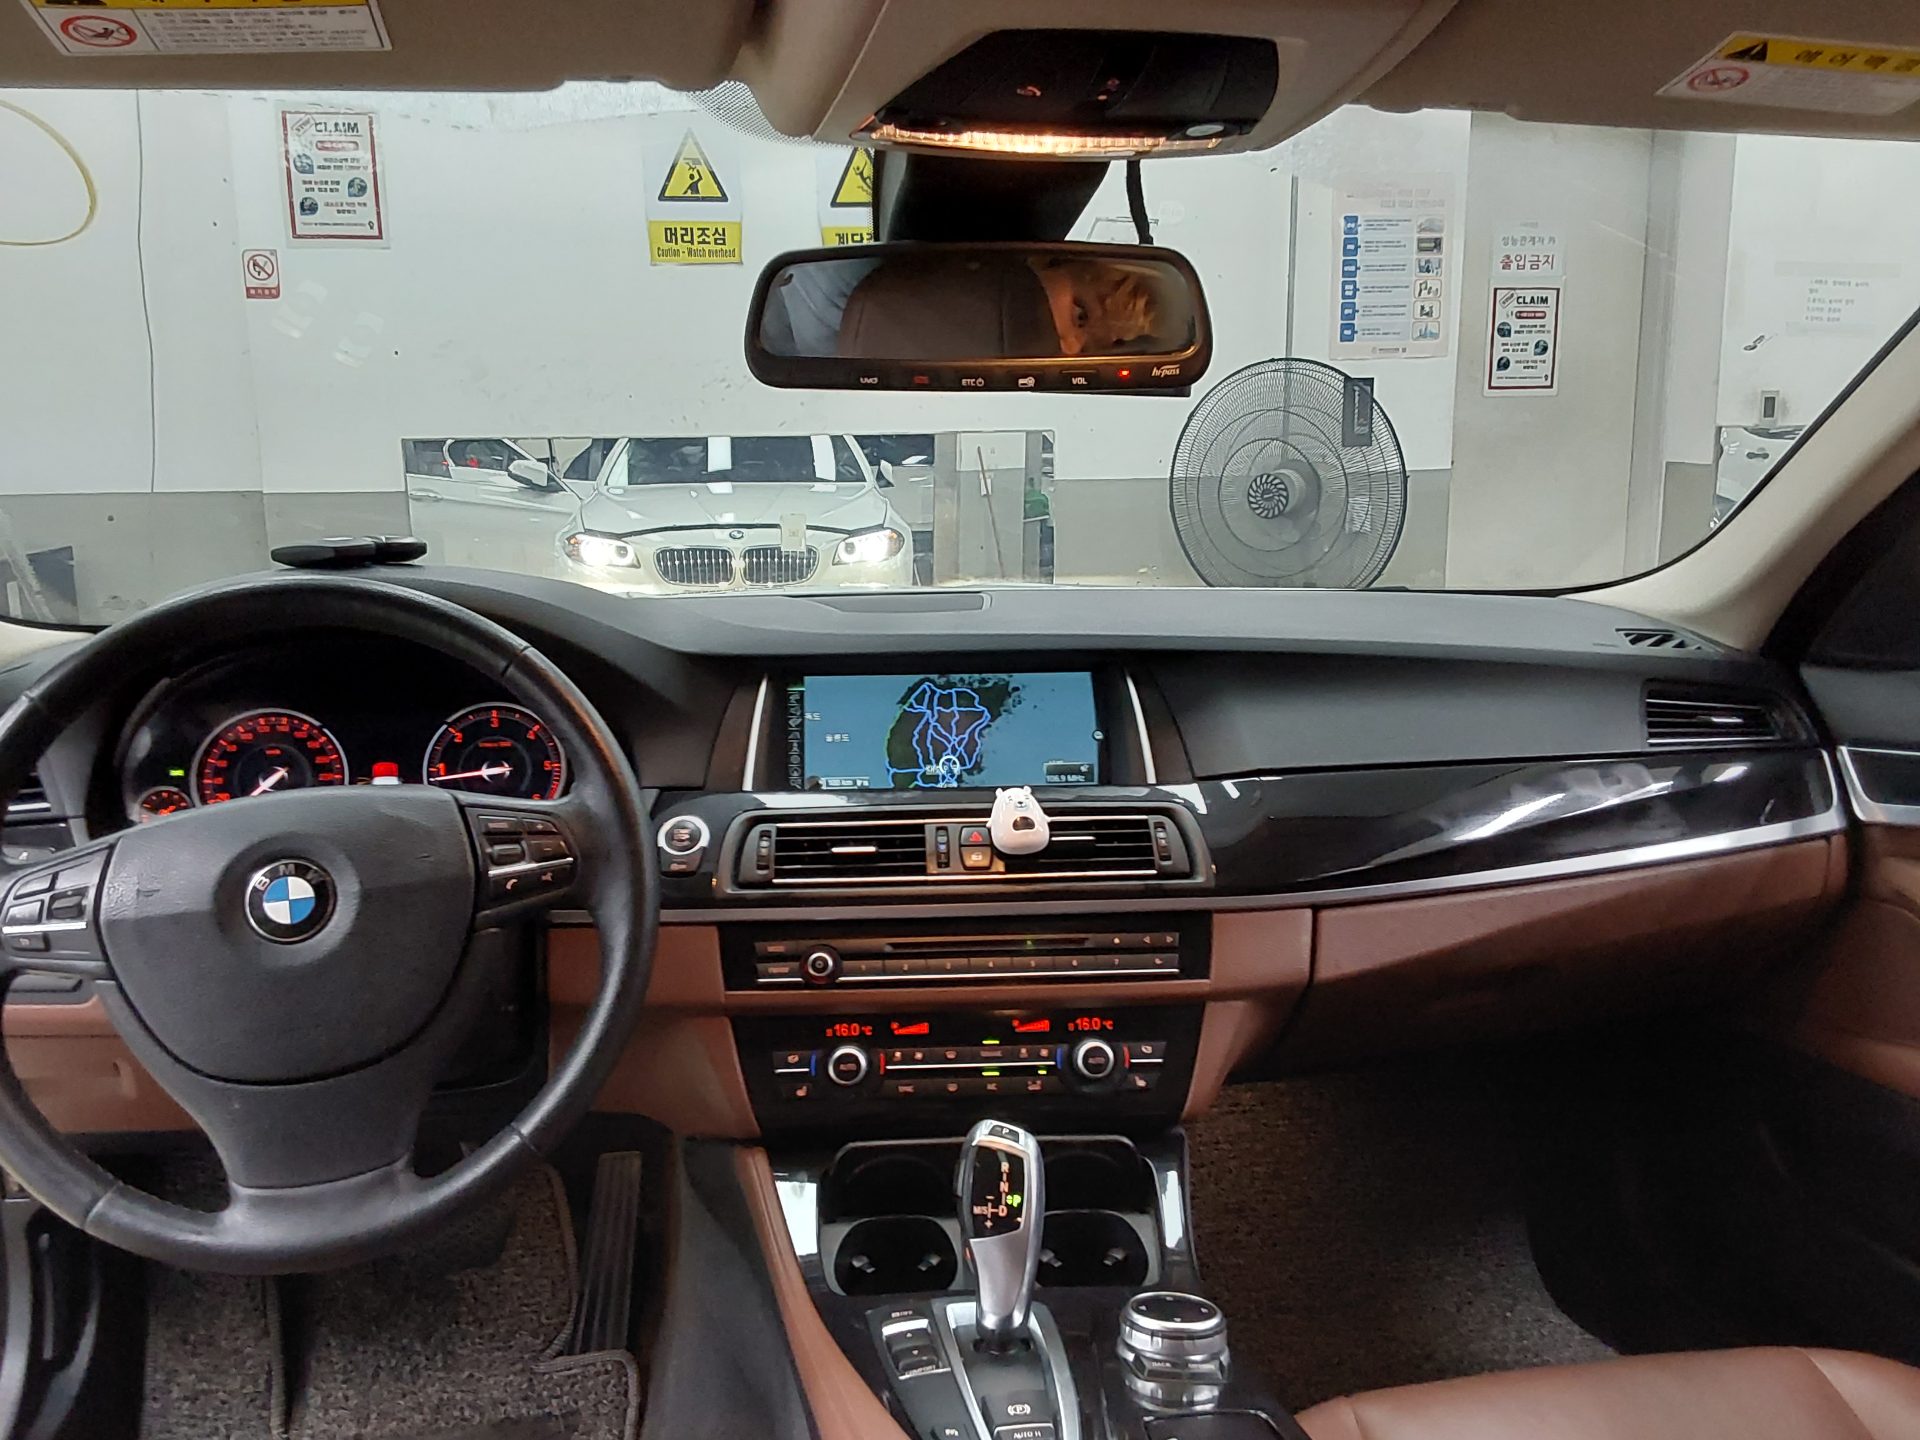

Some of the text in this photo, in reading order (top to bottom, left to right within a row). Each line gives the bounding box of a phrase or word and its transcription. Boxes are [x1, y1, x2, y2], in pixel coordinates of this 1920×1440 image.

[314, 122, 359, 134] CLAIM
[664, 227, 727, 246] 머리조심
[657, 247, 680, 258] Caution
[687, 247, 706, 258] Watch
[708, 248, 736, 258] overhead
[1500, 254, 1555, 271] 출입금지
[1516, 295, 1549, 305] CLAIM
[961, 378, 976, 386] ETC
[1072, 377, 1088, 385] VOL
[255, 863, 324, 891] BMW
[1002, 1127, 1010, 1135] P
[1001, 1162, 1009, 1173] R
[1000, 1182, 1009, 1192] N
[999, 1205, 1007, 1216] D
[1013, 1431, 1033, 1440] AUTO
